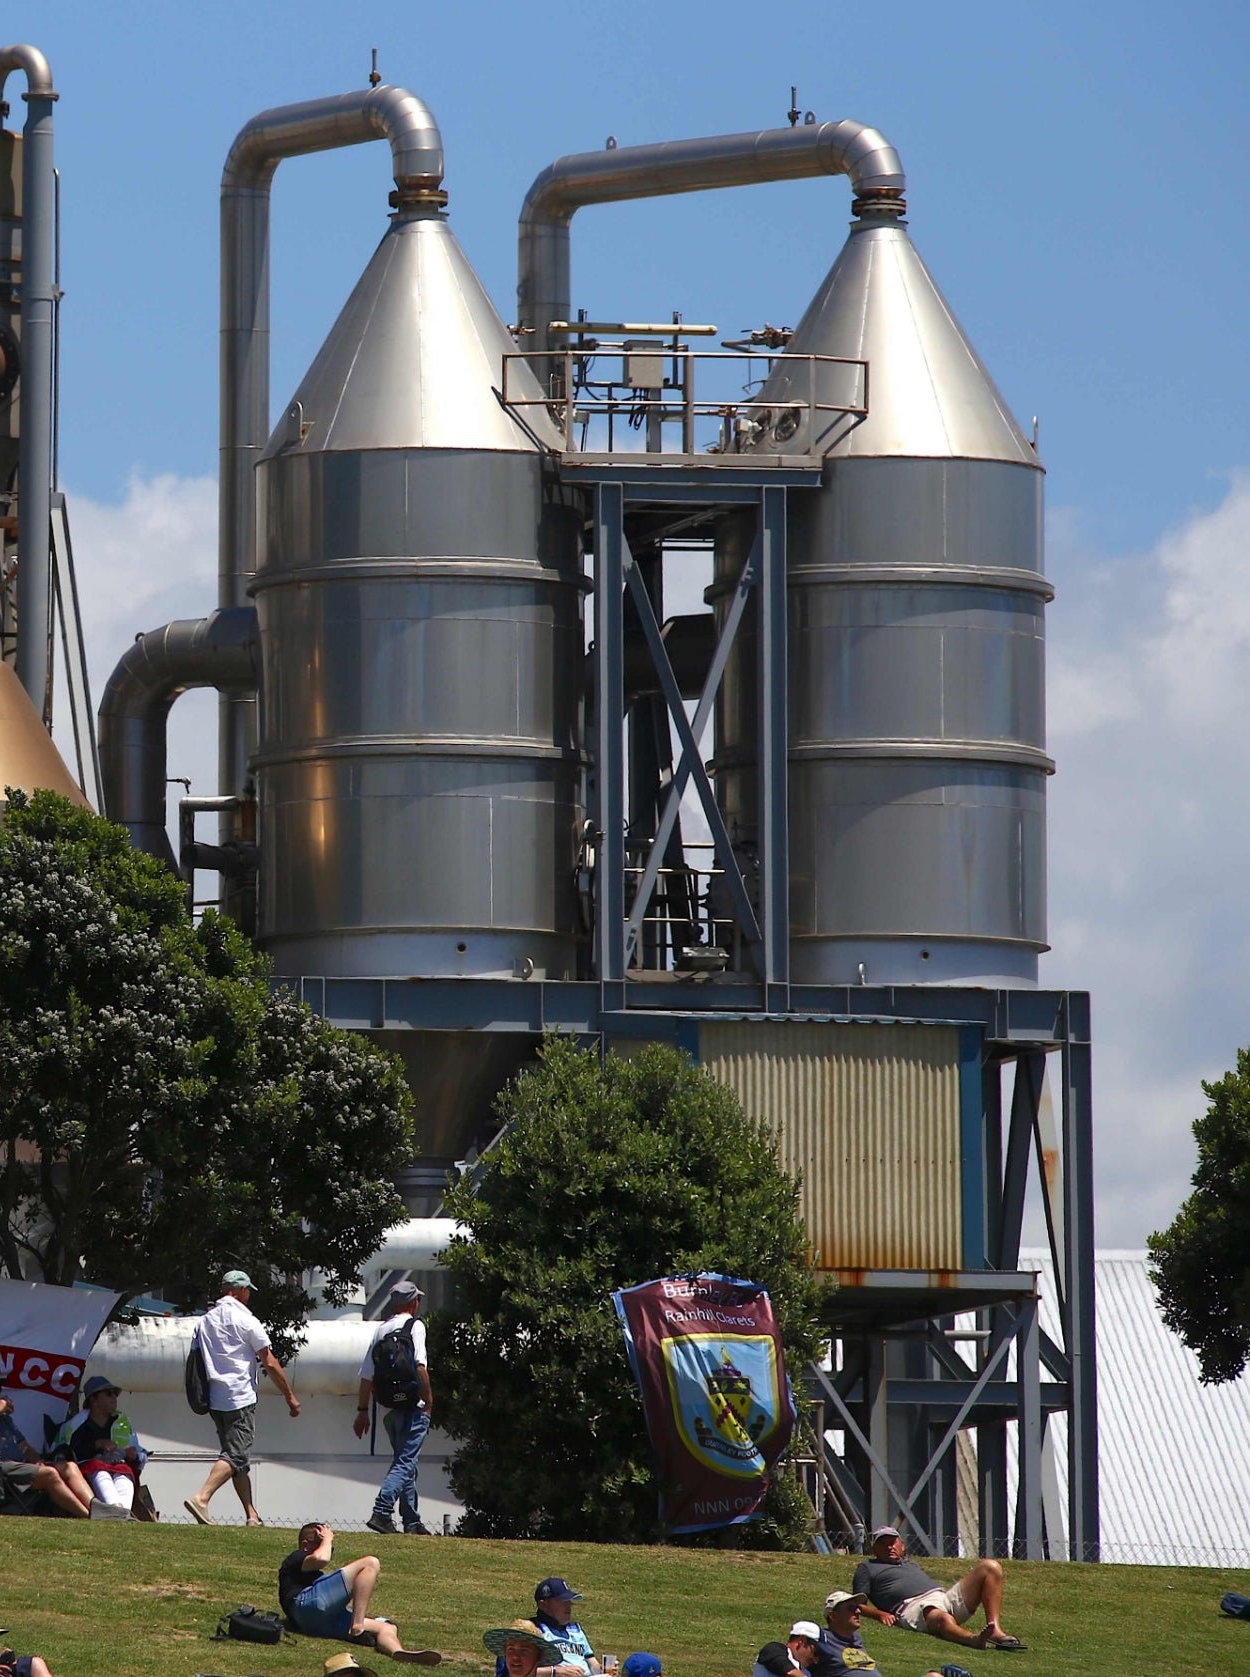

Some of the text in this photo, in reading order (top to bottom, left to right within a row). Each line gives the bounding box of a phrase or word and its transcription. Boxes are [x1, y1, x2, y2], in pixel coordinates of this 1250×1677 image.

[664, 1307, 756, 1327] Rainhill Clarets
[19, 1356, 81, 1394] CC
[694, 1497, 730, 1514] NNN
